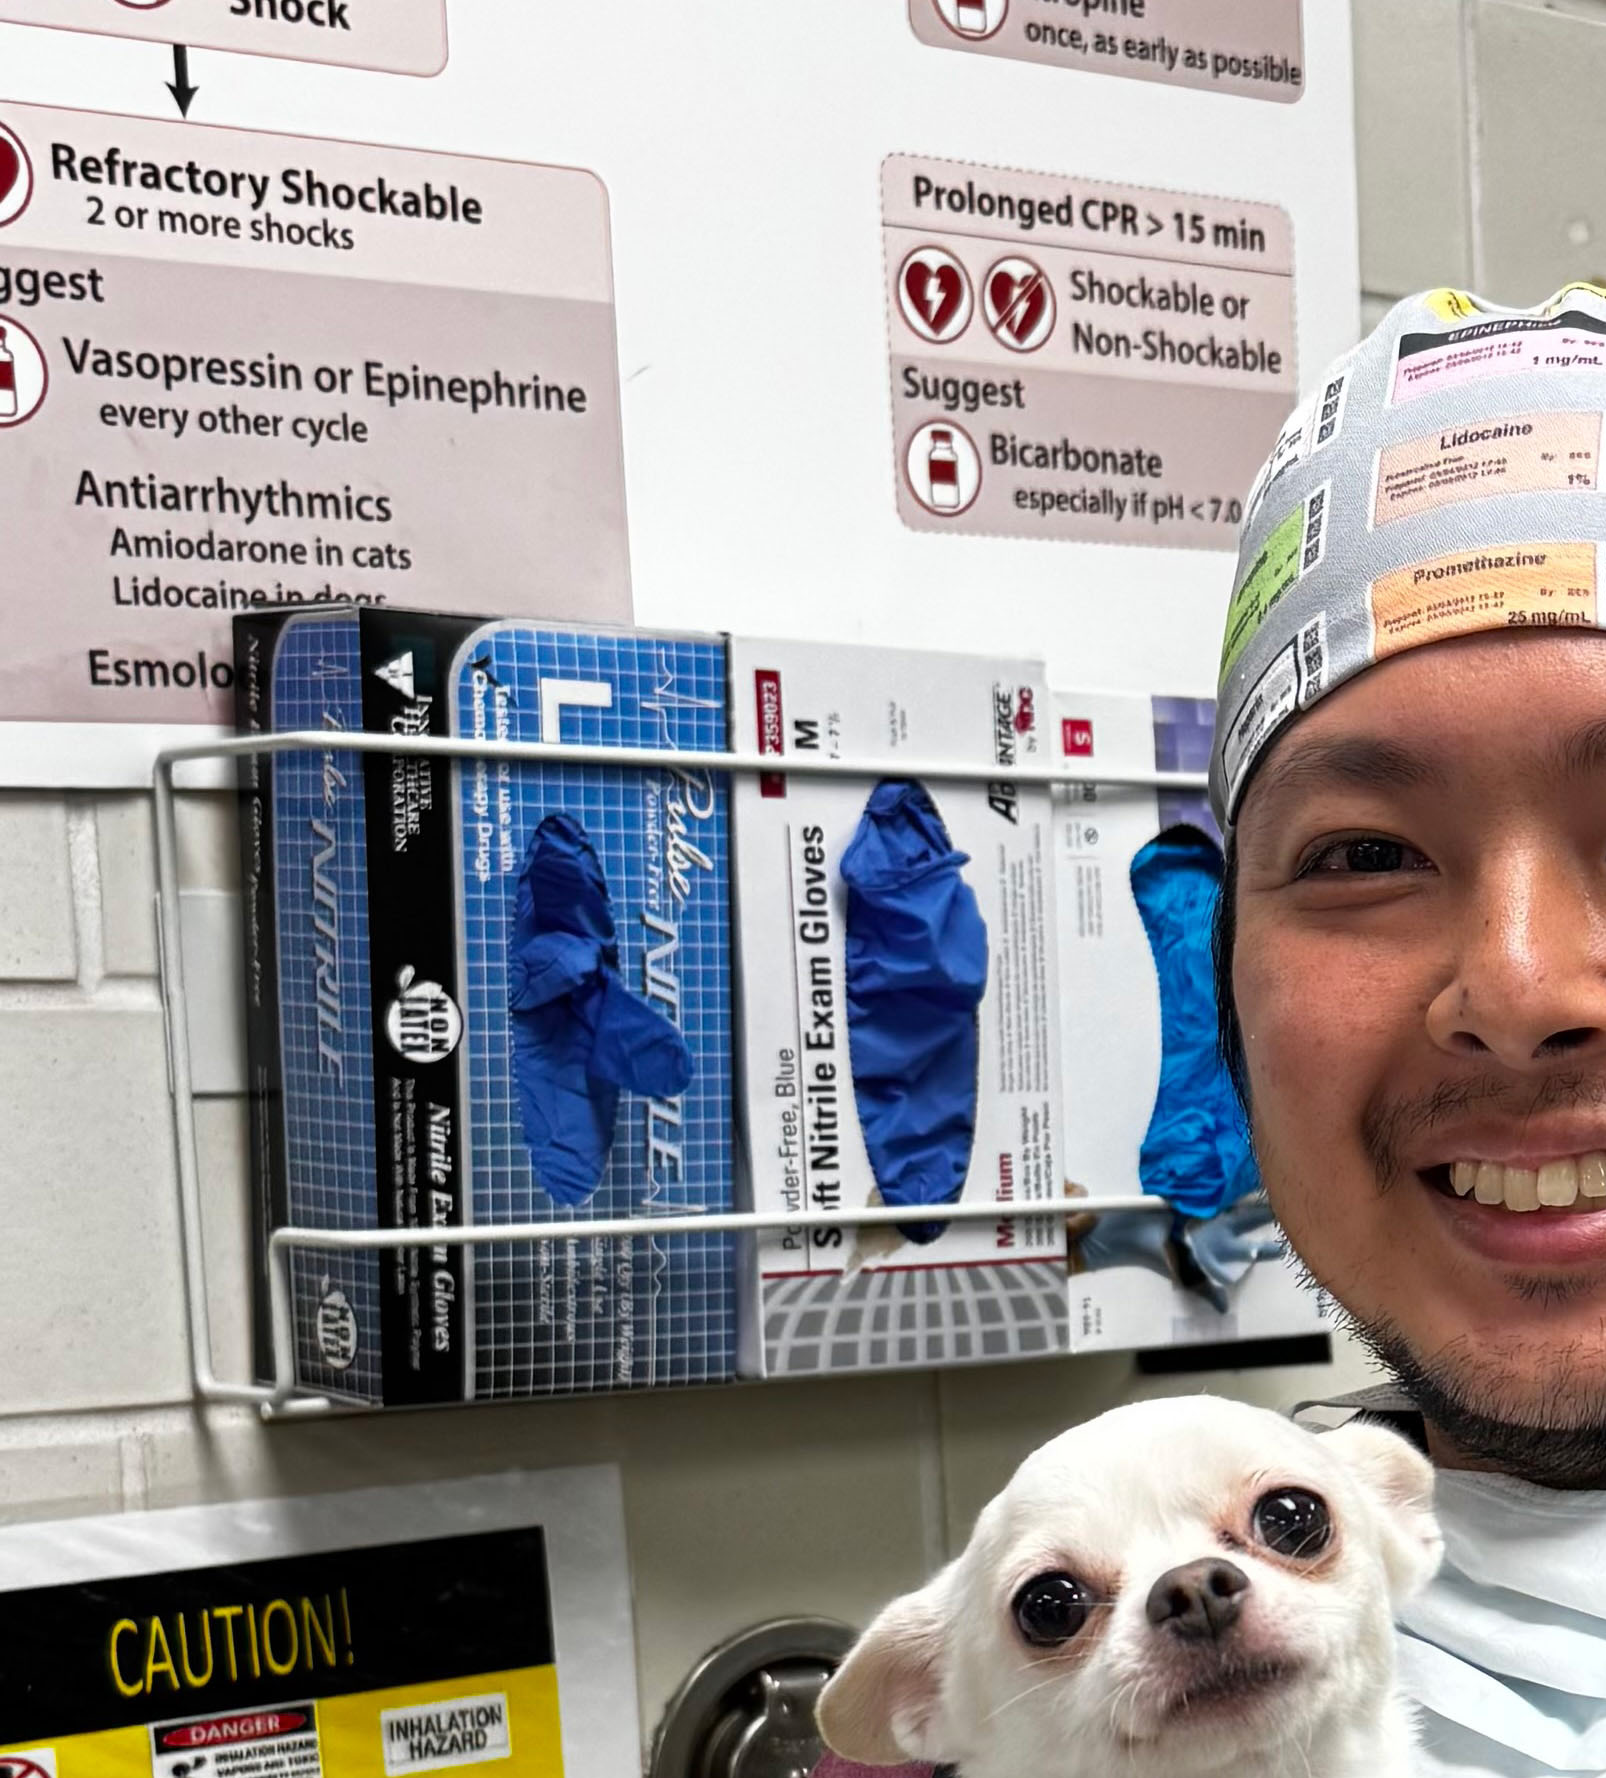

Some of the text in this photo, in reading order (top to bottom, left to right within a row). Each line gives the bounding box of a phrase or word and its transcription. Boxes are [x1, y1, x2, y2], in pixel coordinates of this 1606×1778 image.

[1025, 21, 1302, 86] once, as early as possible
[51, 143, 483, 224] Refractory Shockable
[87, 196, 354, 250] 2 or more shocks
[913, 175, 1266, 253] Prolonged CPR > 15 min
[0, 267, 104, 306] ggest
[1071, 270, 1250, 320] Shockable or
[1072, 324, 1282, 374] Non-Shockable
[63, 337, 587, 414] Vasopressin or Epinephrine
[902, 368, 1026, 413] Suggest
[99, 402, 369, 446] every other cycle
[1440, 423, 1533, 451] Lidocaine
[990, 433, 1163, 479] Bicarbonate
[75, 471, 392, 523] Antiarrhythmics
[1014, 486, 1131, 519] especially
[1134, 490, 1150, 516] if
[1152, 494, 1185, 523] pH
[1209, 497, 1242, 525] 7.0
[110, 528, 412, 569] Amiodarone in cats
[1414, 552, 1547, 584] Promethazine
[113, 576, 302, 610] Lidocaine in
[1508, 609, 1592, 626] 25 mg/mL
[89, 649, 235, 689] Esmolo
[541, 676, 612, 744] L
[793, 719, 820, 749] M
[1075, 730, 1091, 747] S
[475, 821, 494, 882] Drugs
[644, 778, 665, 912] Powder-Free
[662, 764, 715, 908] Pulse
[310, 818, 345, 1089] NITRILE
[401, 996, 432, 1056] LATEX
[429, 998, 451, 1052] NON
[798, 825, 843, 1248] Sft Nitrile Exam Gloves
[774, 1048, 796, 1098] Blue
[428, 1102, 455, 1353] Nitrile Exm Gloves
[320, 1297, 340, 1361] LATEX
[336, 1319, 354, 1362] NON
[108, 1587, 356, 1697] CAUTION!
[190, 1714, 281, 1743] DANGER
[388, 1703, 503, 1742] INHALATION
[409, 1728, 488, 1762] HAZARD
